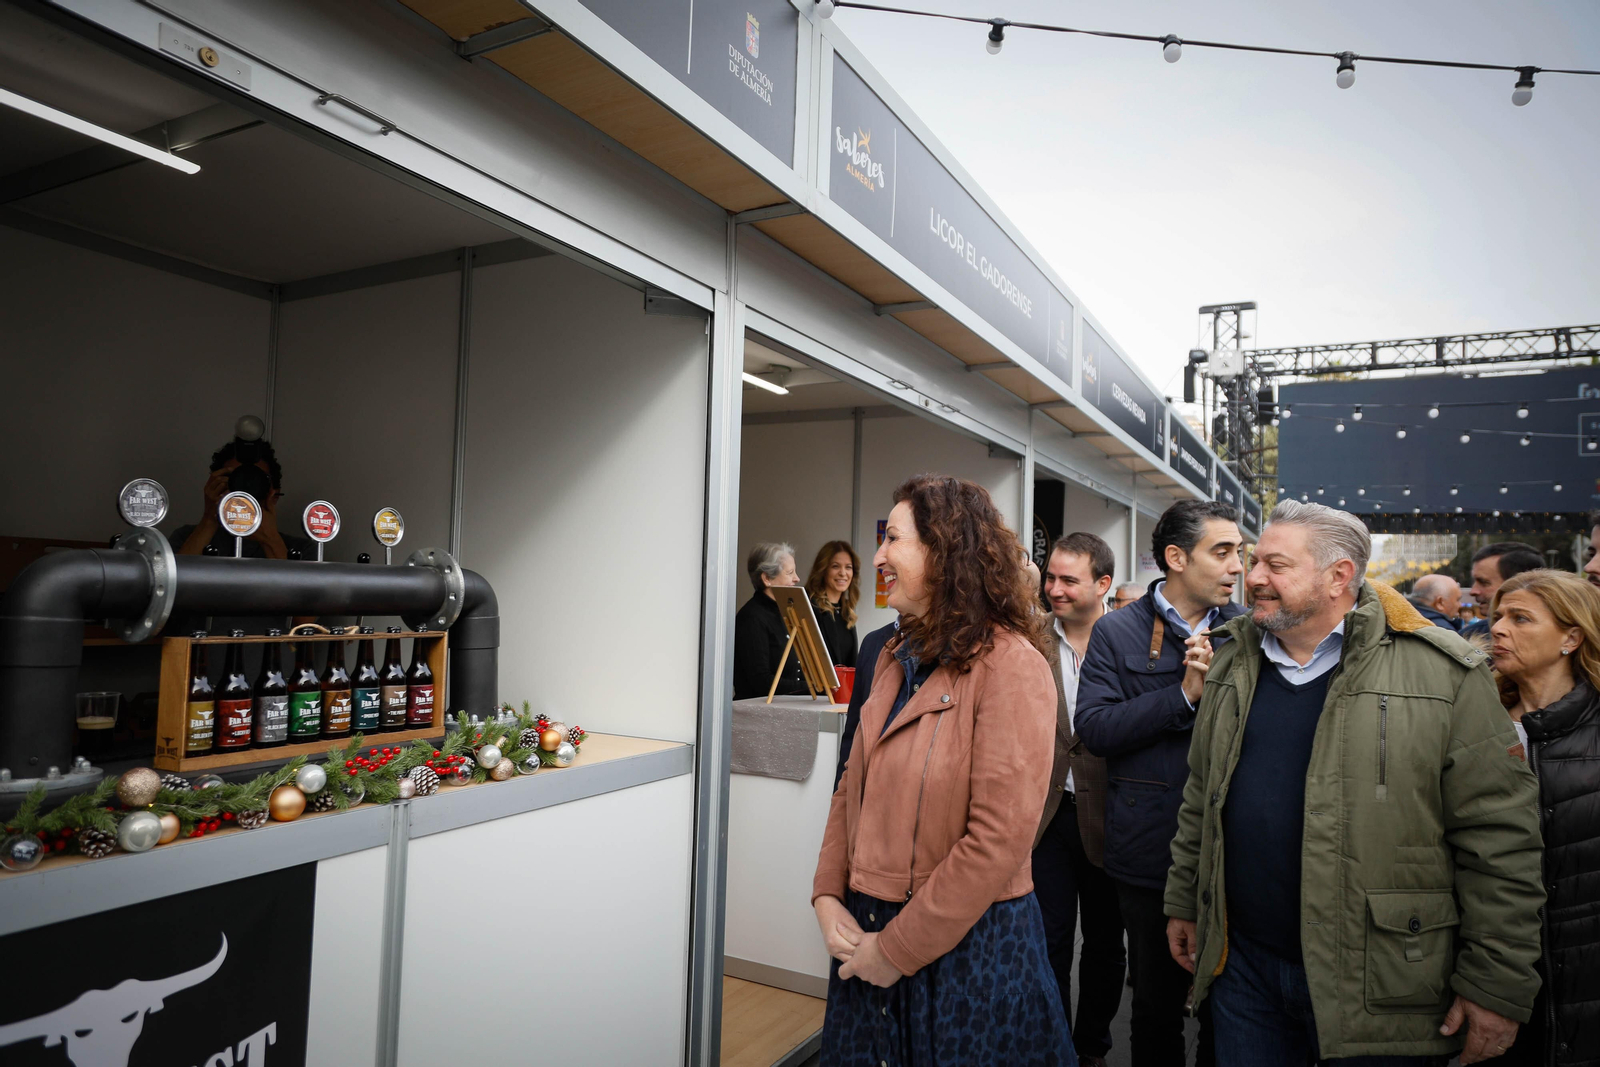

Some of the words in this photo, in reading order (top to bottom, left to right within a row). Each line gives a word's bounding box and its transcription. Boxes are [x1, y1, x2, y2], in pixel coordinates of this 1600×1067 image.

[729, 43, 774, 92] DIPUTACIÓN
[729, 59, 740, 77] DE
[740, 71, 772, 106] ALMERÍA
[930, 207, 964, 258] LICOR
[966, 241, 979, 271] EL
[980, 256, 1032, 319] GADORENSE
[129, 496, 141, 505] FAR
[142, 497, 158, 506] WEST
[227, 511, 238, 519] FAR
[238, 512, 251, 520] WEST
[1034, 529, 1046, 566] CRAF
[361, 700, 372, 708] FAR
[389, 697, 399, 705] FAR
[415, 696, 425, 704] FAR
[267, 710, 279, 719] FAR
[280, 709, 288, 717] WES
[299, 708, 311, 716] FAR
[312, 706, 321, 714] WES
[331, 705, 342, 714] FAR
[190, 719, 204, 728] FAR
[205, 718, 214, 727] WES
[229, 717, 242, 726] FAR
[242, 715, 252, 724] WES
